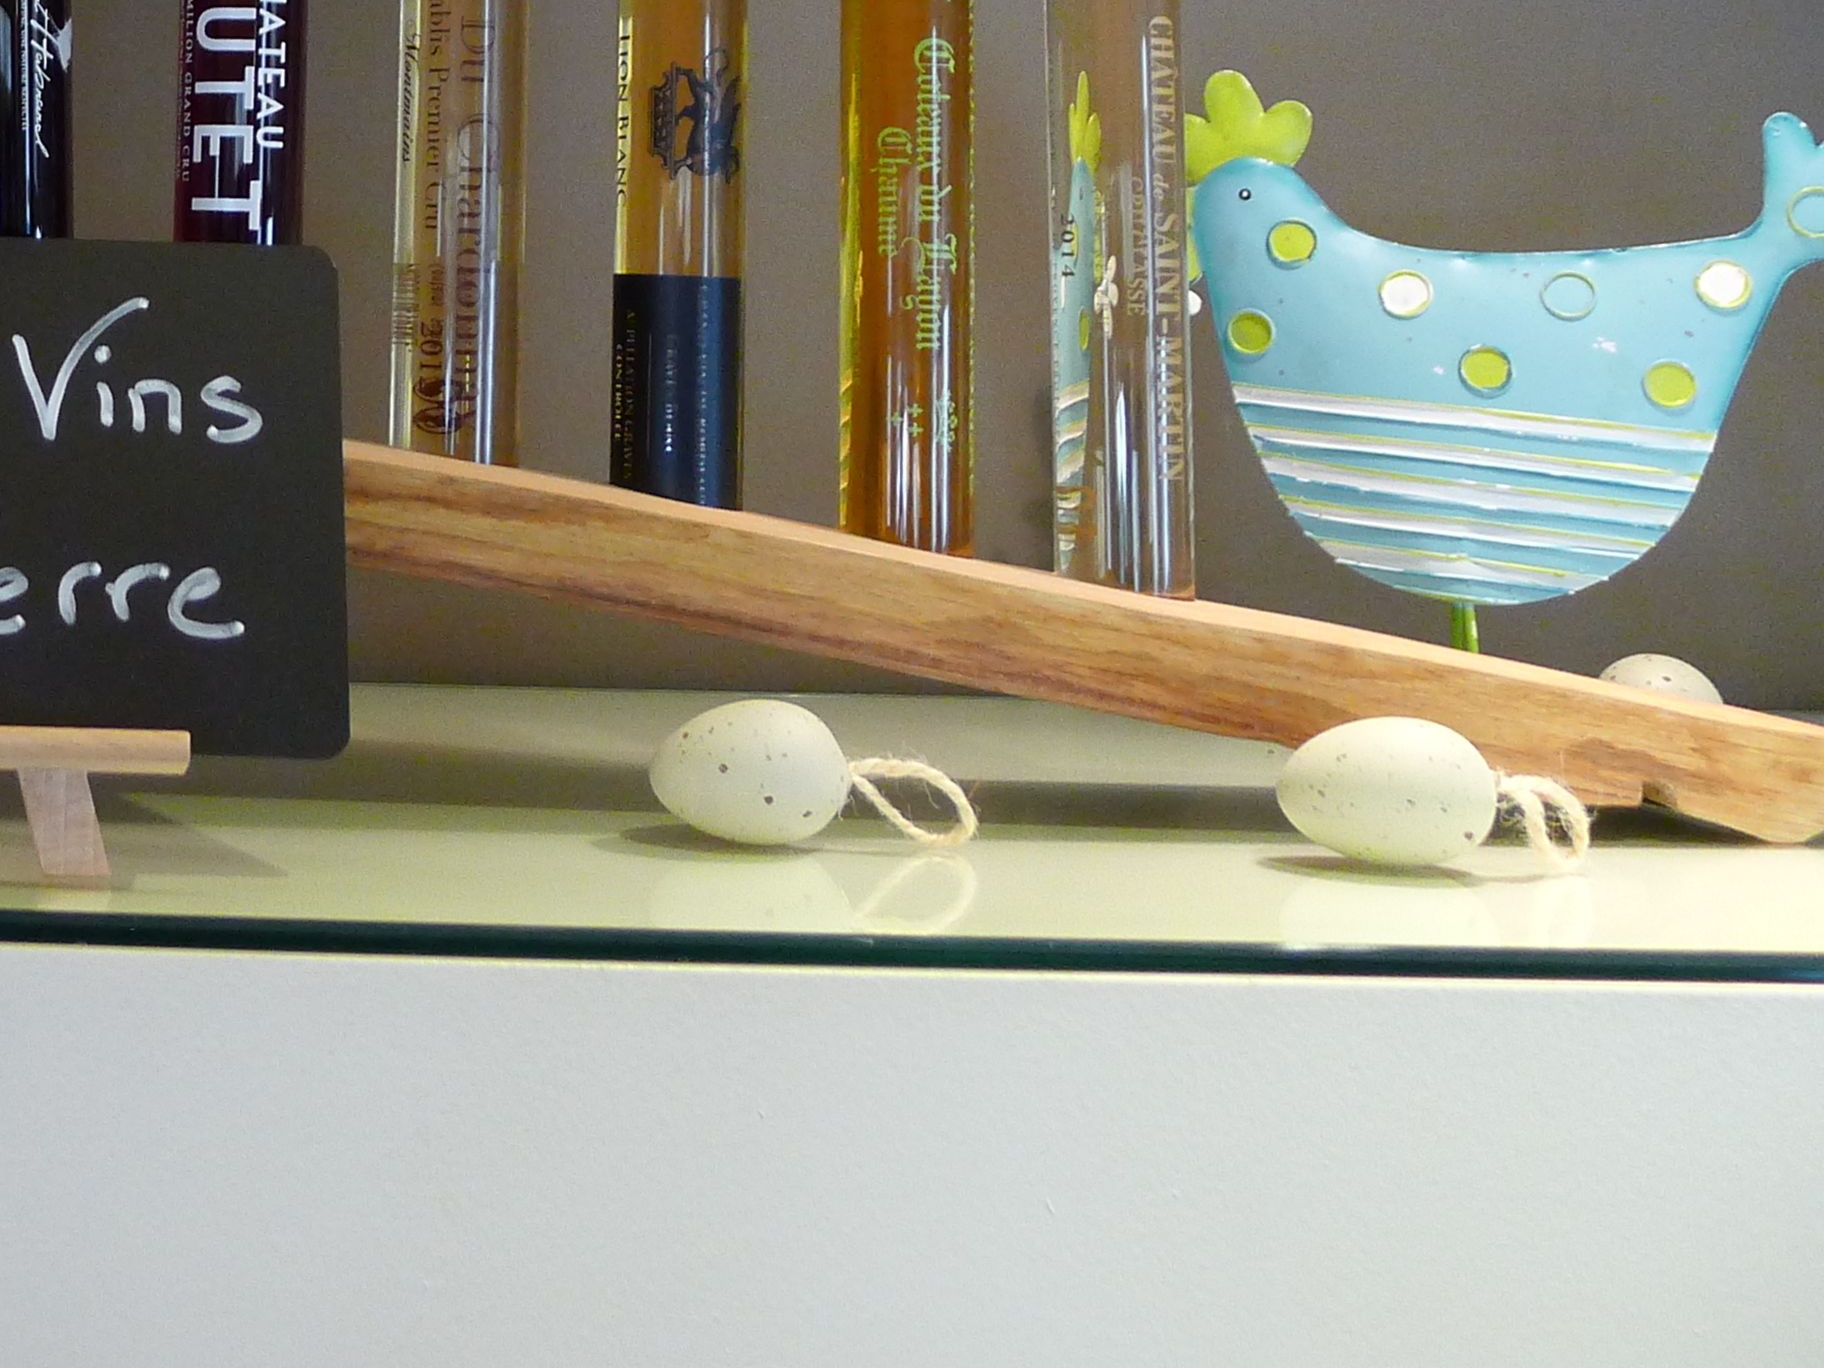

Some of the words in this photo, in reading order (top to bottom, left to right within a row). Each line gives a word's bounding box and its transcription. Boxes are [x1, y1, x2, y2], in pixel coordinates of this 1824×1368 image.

[182, 72, 193, 137] GRAND
[401, 32, 423, 164] Montmains
[460, 16, 496, 84] Du
[914, 37, 955, 171] Coteaux
[1147, 15, 1179, 165] CHÂTEAU
[180, 144, 191, 183] CRU
[425, 67, 450, 172] Premier
[424, 181, 446, 230] Cru
[870, 126, 913, 258] Chaume
[1151, 173, 1169, 202] de
[900, 232, 958, 350] Layon
[1060, 214, 1076, 278] 2014
[12, 296, 264, 444] Vins
[1154, 212, 1186, 482] SAINT-MARTIN
